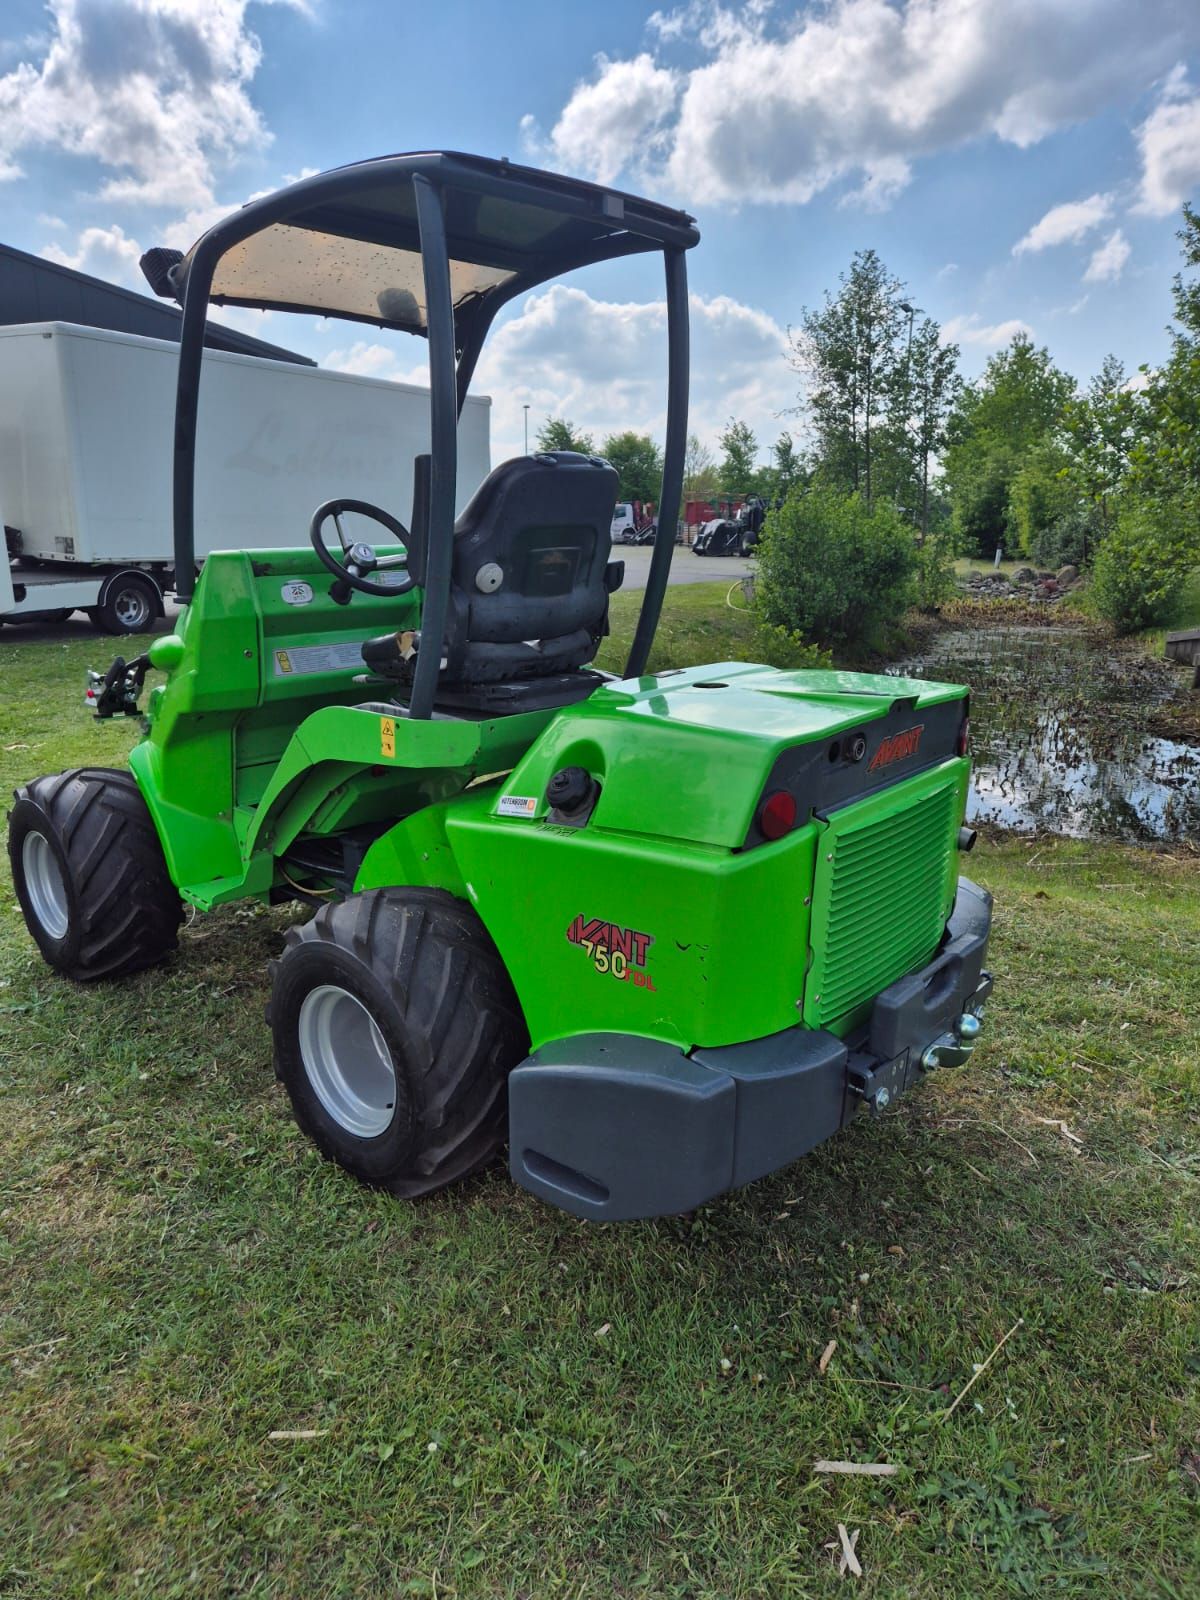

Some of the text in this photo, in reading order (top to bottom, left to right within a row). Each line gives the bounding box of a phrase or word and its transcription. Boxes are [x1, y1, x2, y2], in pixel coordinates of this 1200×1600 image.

[866, 724, 925, 775] AVANT
[566, 913, 652, 967] AVANT
[581, 939, 657, 993] 750 TDL
